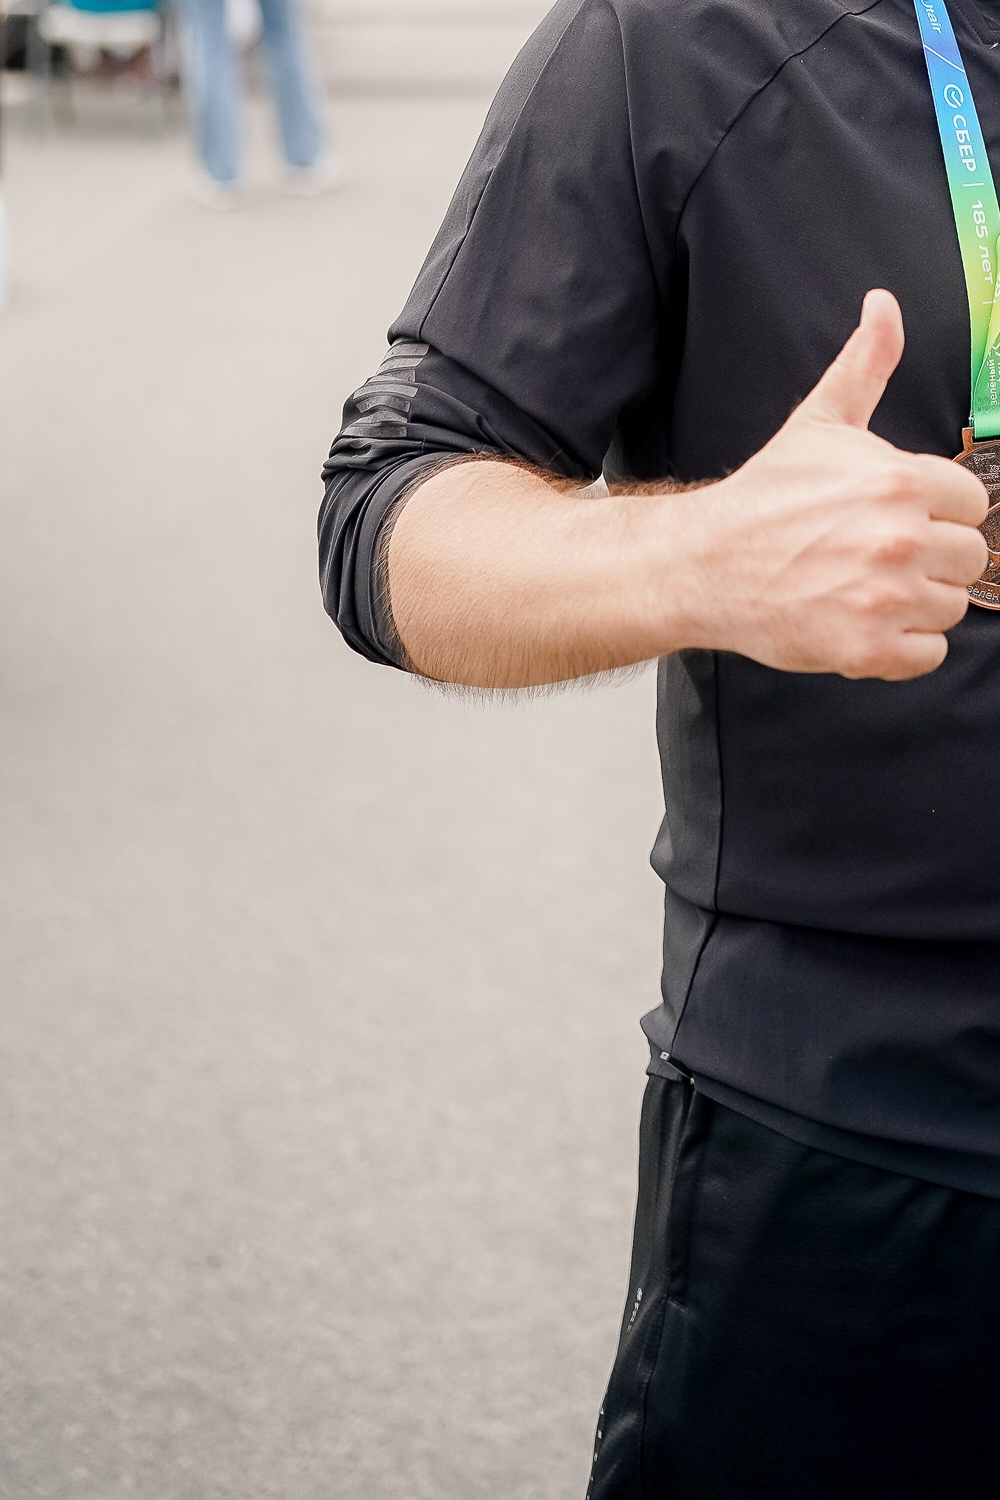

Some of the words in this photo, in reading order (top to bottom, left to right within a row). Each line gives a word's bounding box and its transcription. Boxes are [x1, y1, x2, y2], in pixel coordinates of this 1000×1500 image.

[952, 113, 978, 173] СБЕР
[971, 200, 989, 239] 185
[978, 243, 994, 285] лет
[986, 358, 999, 406] зелёный
